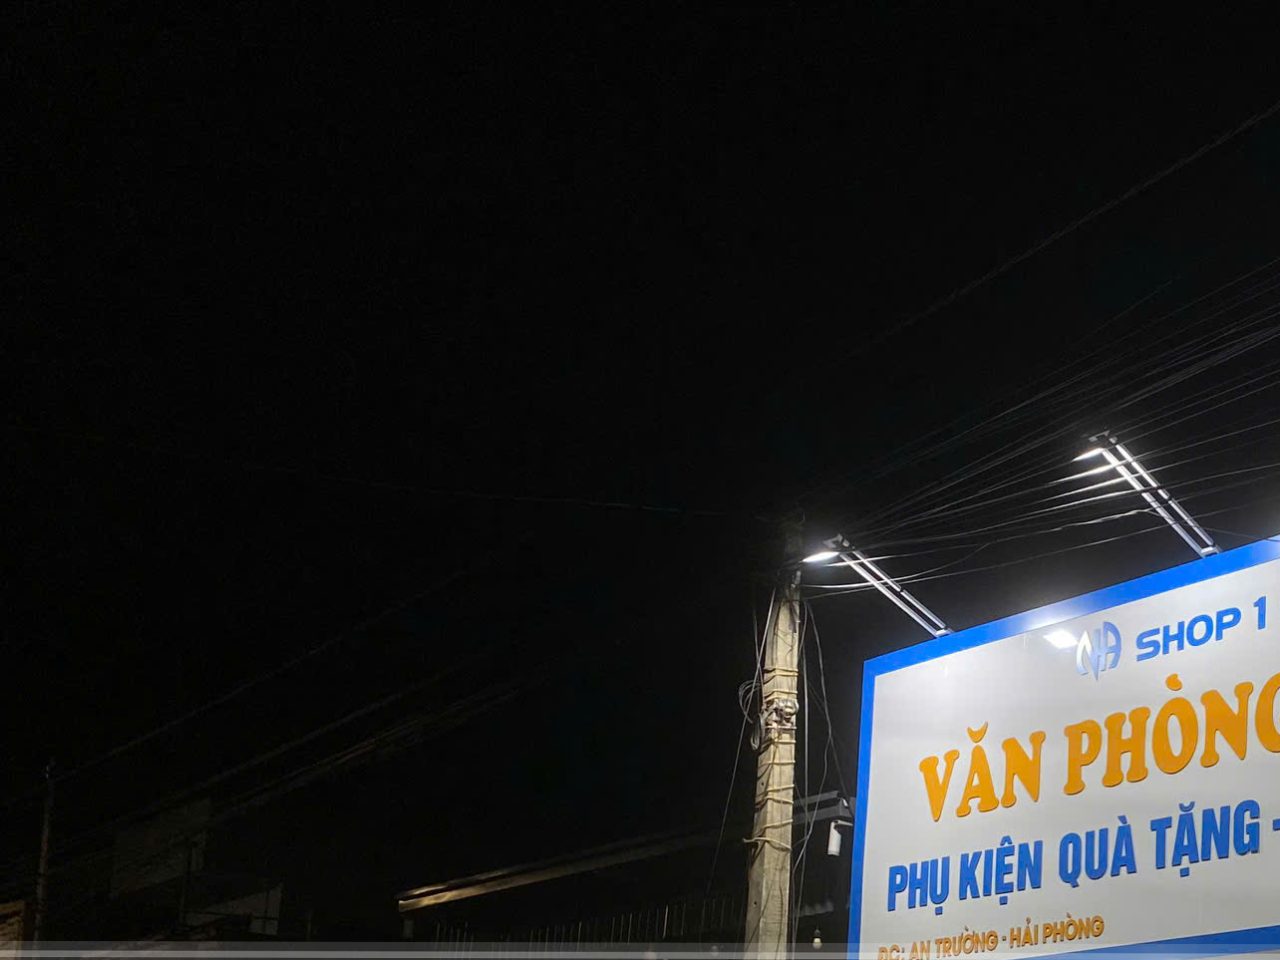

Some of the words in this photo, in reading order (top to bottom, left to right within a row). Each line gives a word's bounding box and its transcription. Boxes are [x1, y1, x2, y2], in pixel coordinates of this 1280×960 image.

[1136, 607, 1242, 662] SHOP
[1253, 596, 1267, 630] 1
[918, 721, 1046, 821] VĂN
[887, 856, 950, 915] PHỤ
[958, 836, 1044, 905] KIỆN
[1058, 815, 1137, 888] QUÀ
[1150, 800, 1260, 877] TẶNG
[934, 924, 999, 959] TRƯỜNG
[1009, 917, 1039, 949] HẢI
[1042, 912, 1105, 945] PHÒNG
